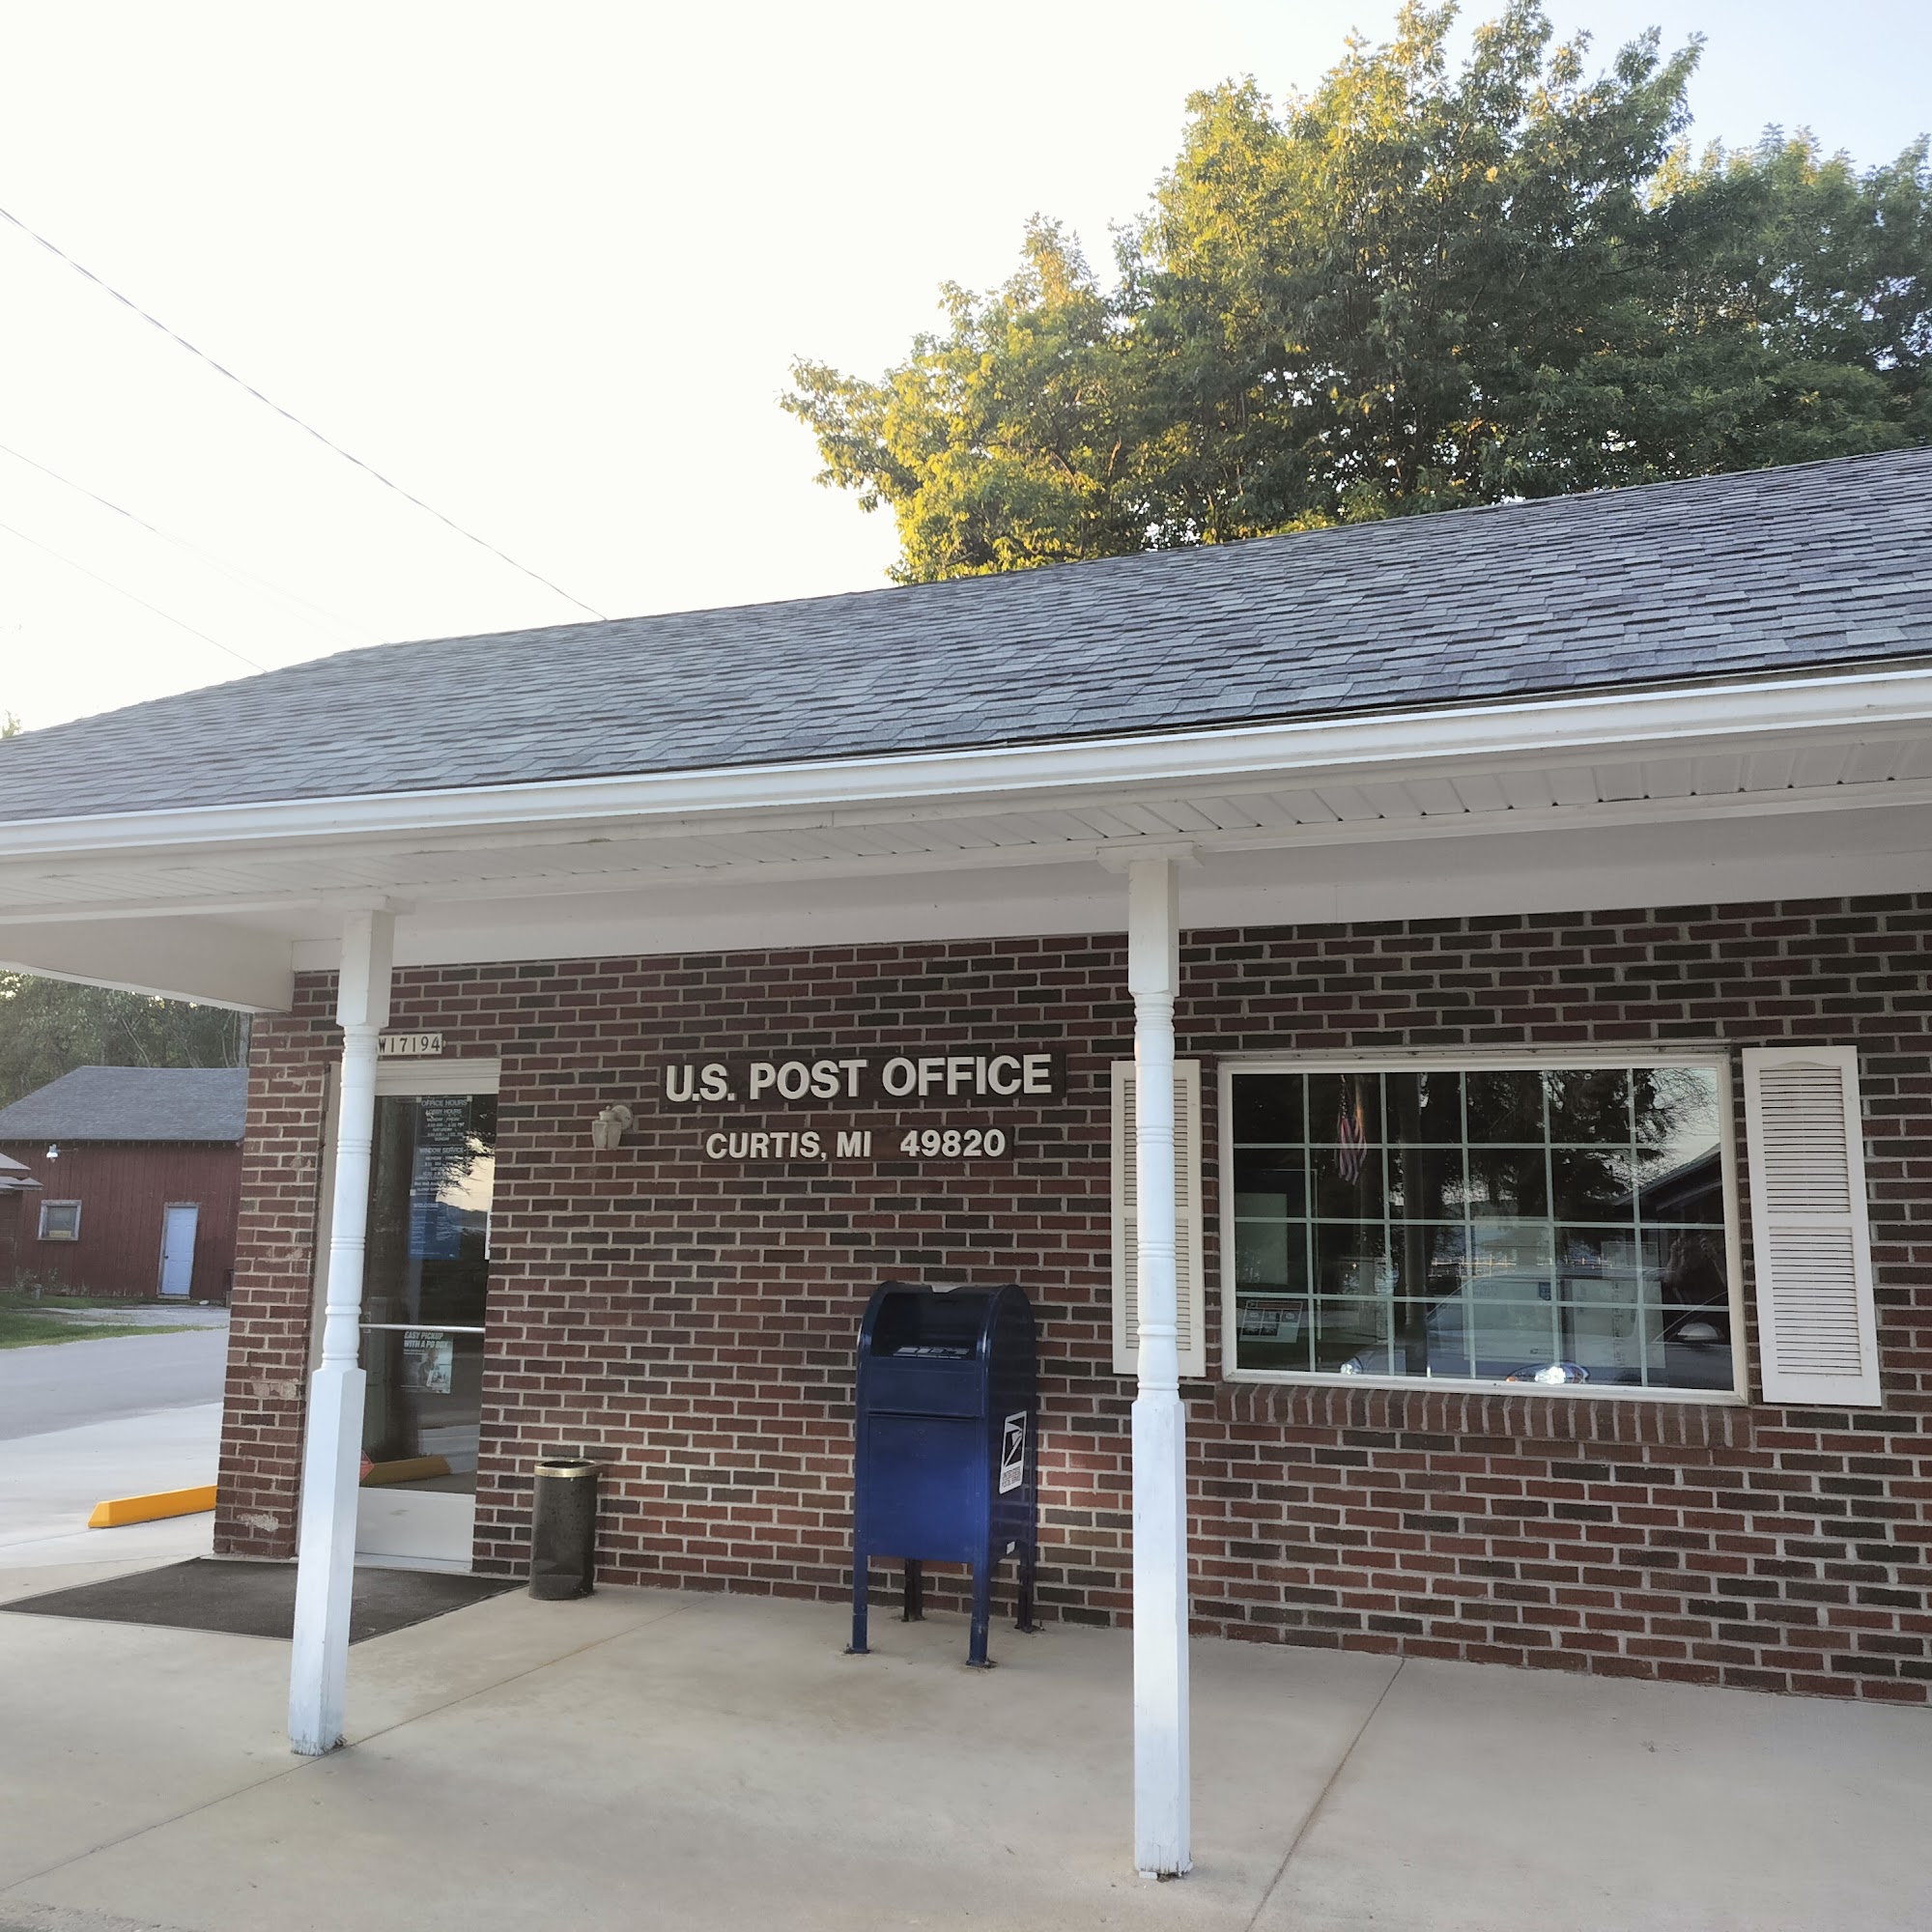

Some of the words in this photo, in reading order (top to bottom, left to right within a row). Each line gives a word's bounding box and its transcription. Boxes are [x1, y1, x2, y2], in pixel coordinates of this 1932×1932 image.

[379, 1037, 440, 1053] W17194
[666, 1063, 737, 1102] U.S.
[750, 1059, 868, 1101] POST
[882, 1053, 1053, 1097] OFFICE
[706, 1131, 827, 1161] CURTIS,
[837, 1130, 871, 1157] MI
[900, 1129, 1006, 1157] 49820
